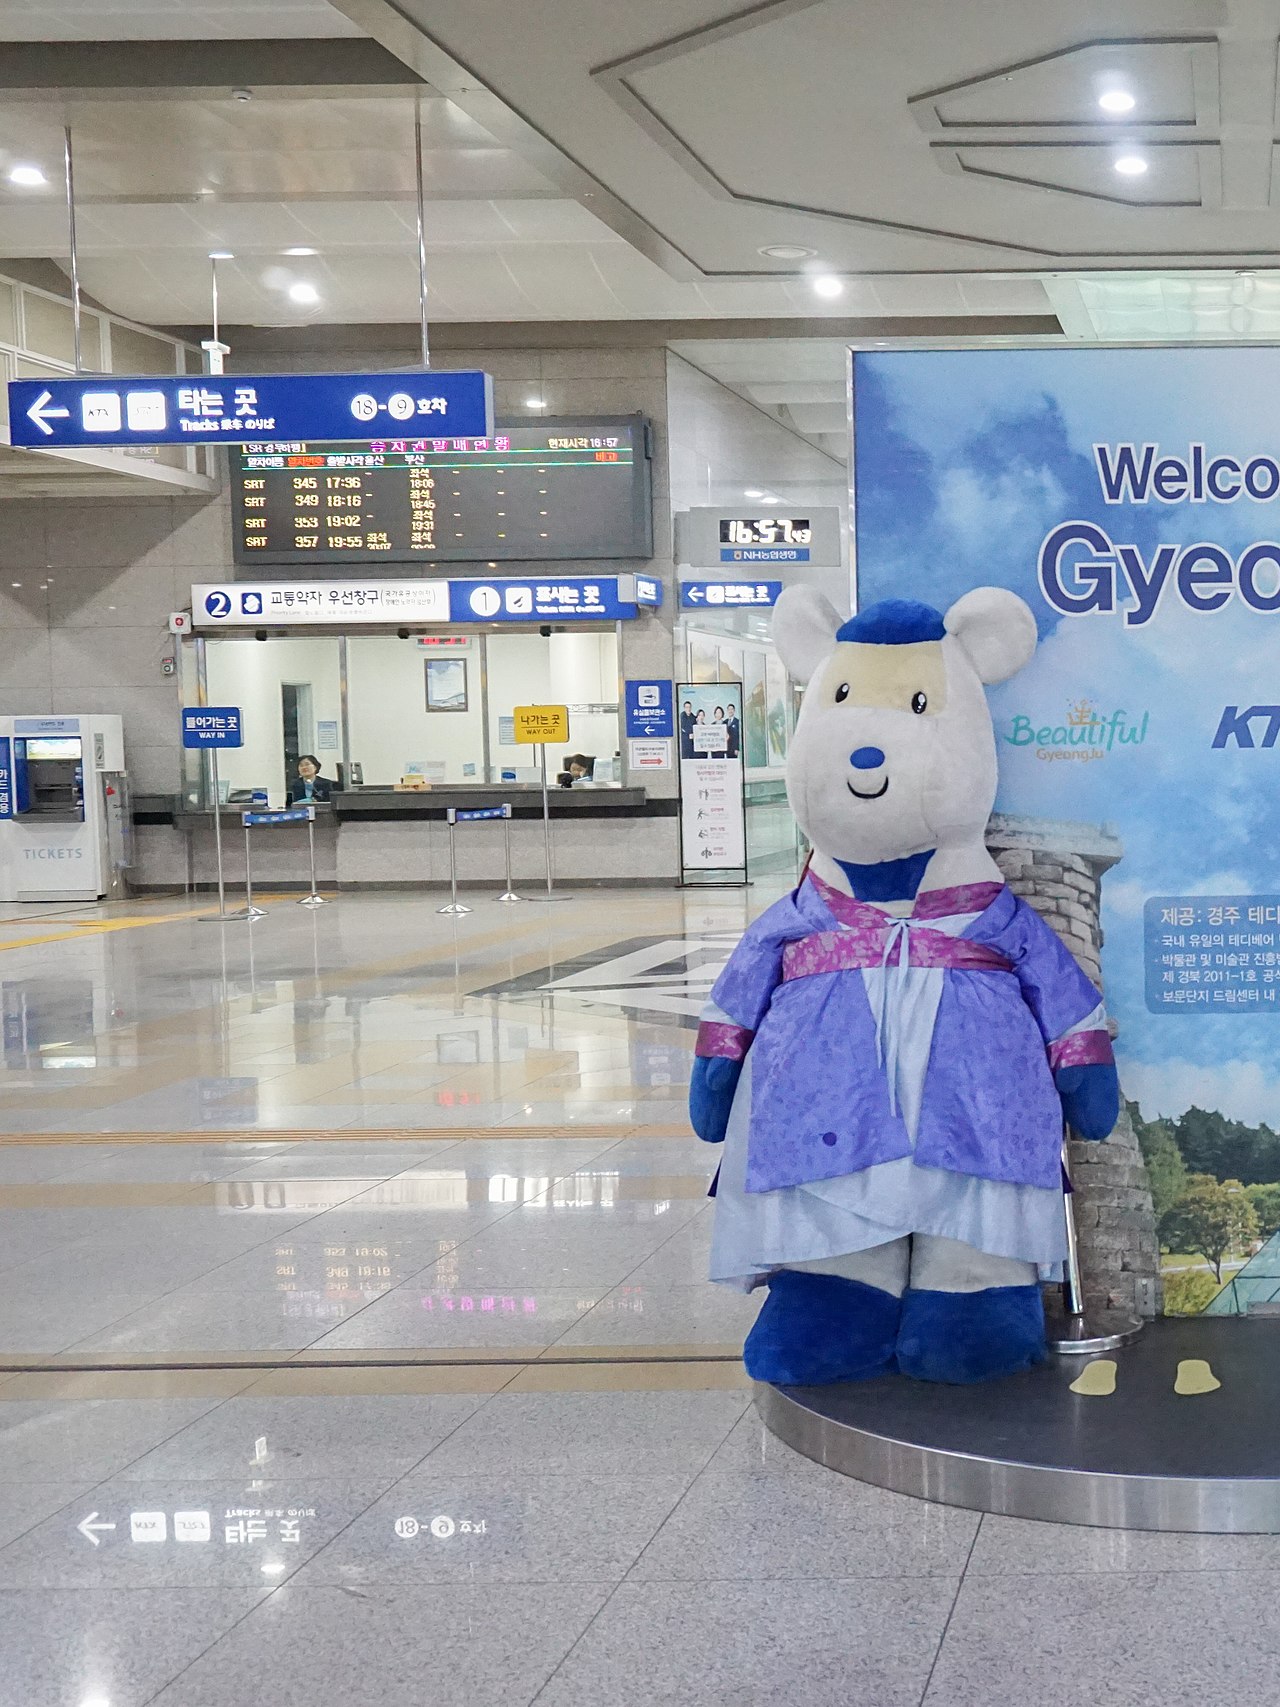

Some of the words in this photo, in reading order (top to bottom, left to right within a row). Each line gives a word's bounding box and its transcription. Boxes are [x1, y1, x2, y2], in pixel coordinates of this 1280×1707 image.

[178, 389, 224, 416] 타는
[234, 389, 258, 416] 곳
[179, 419, 220, 432] Tracks
[548, 437, 588, 449] 현재시각
[589, 437, 618, 448] 16:57
[594, 452, 618, 462] 비고
[243, 479, 266, 490] SRT
[293, 477, 318, 489] 345
[326, 477, 362, 488] 17:36
[410, 479, 435, 489] 18:06
[244, 497, 266, 507] SRT
[295, 494, 319, 507] 349
[327, 495, 362, 507] 18:16
[410, 499, 436, 510] 18:45
[245, 518, 267, 529] SRT
[294, 517, 319, 528] 353
[326, 515, 362, 527] 19:02
[411, 521, 435, 531] 19:31
[729, 519, 793, 544] 16:57
[245, 536, 268, 547] SRT
[295, 536, 319, 548] 357
[327, 536, 363, 548] 19:55
[743, 550, 797, 560] NH농협생명
[210, 593, 227, 616] 2
[271, 590, 323, 607] 교통약자
[328, 589, 379, 606] 우선창구
[186, 716, 225, 729] 들어가는
[227, 716, 237, 729] 곳
[520, 715, 549, 726] 나가는
[551, 714, 560, 726] 곳
[198, 731, 215, 739] WAY
[216, 731, 225, 739] IN
[1004, 708, 1149, 751] Beautiful
[24, 847, 82, 860] TICKETS
[1161, 907, 1202, 926] 제공:
[1207, 906, 1241, 926] 경주
[1161, 934, 1185, 947] 국내
[1189, 934, 1224, 947] 유일의
[1228, 933, 1274, 947] 테디베어
[1161, 954, 1196, 967] 박물관
[1200, 953, 1212, 966] 및
[1215, 953, 1250, 966] 미술관
[1162, 971, 1174, 983] 제
[1177, 971, 1200, 984] 경북
[1204, 970, 1257, 983] 2011-1호
[1162, 990, 1209, 1003] 보문단지
[1212, 989, 1260, 1003] 드림센터
[1263, 988, 1275, 1001] 내
